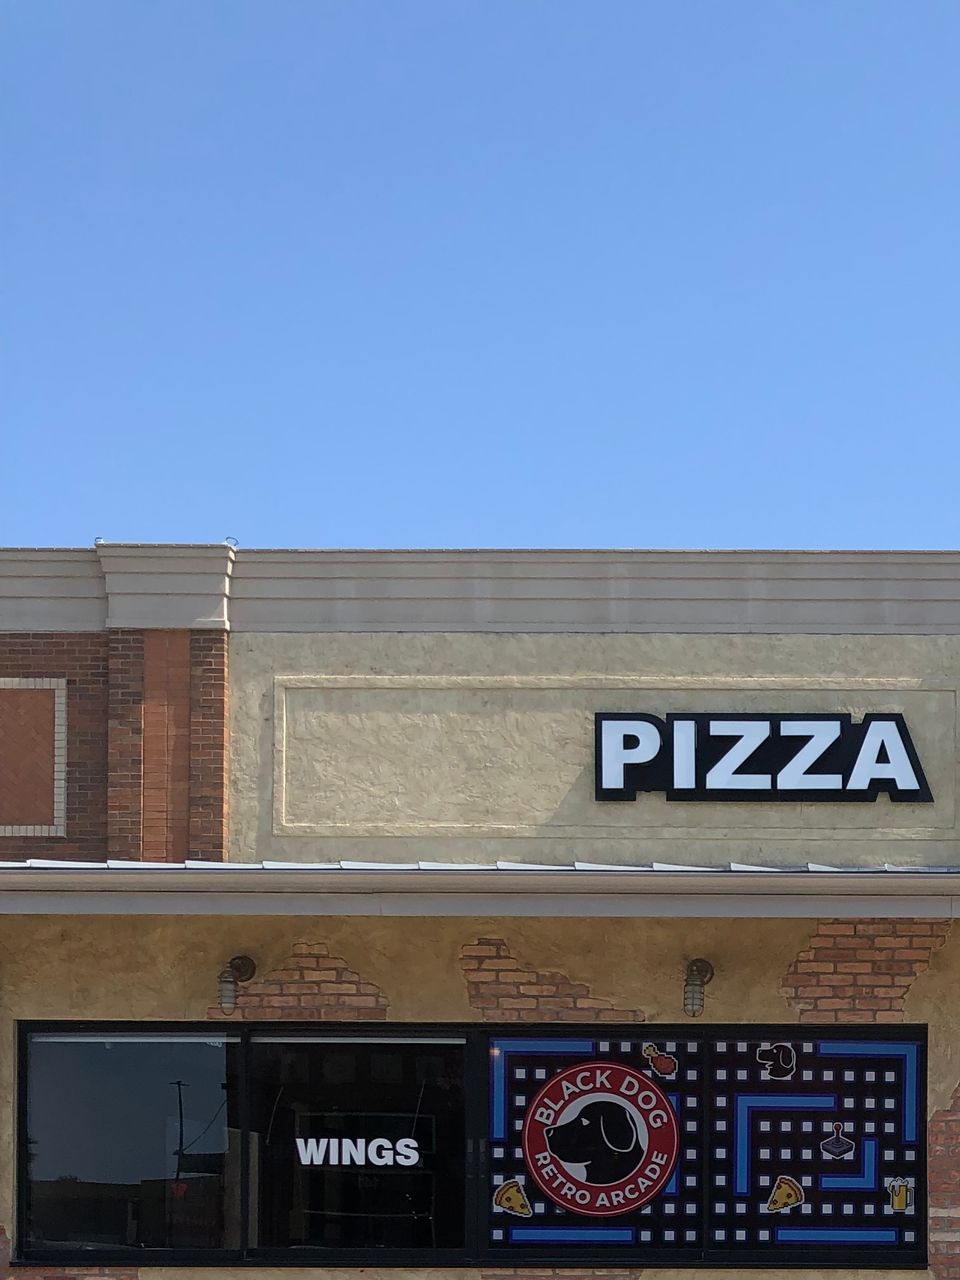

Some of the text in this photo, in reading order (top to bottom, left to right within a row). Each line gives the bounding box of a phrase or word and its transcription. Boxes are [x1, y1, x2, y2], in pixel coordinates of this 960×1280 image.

[600, 720, 921, 790] PIZZA
[534, 1068, 668, 1130] BLACK DOG
[296, 1138, 420, 1166] WINGS
[534, 1149, 669, 1208] RETRO ARCADE
